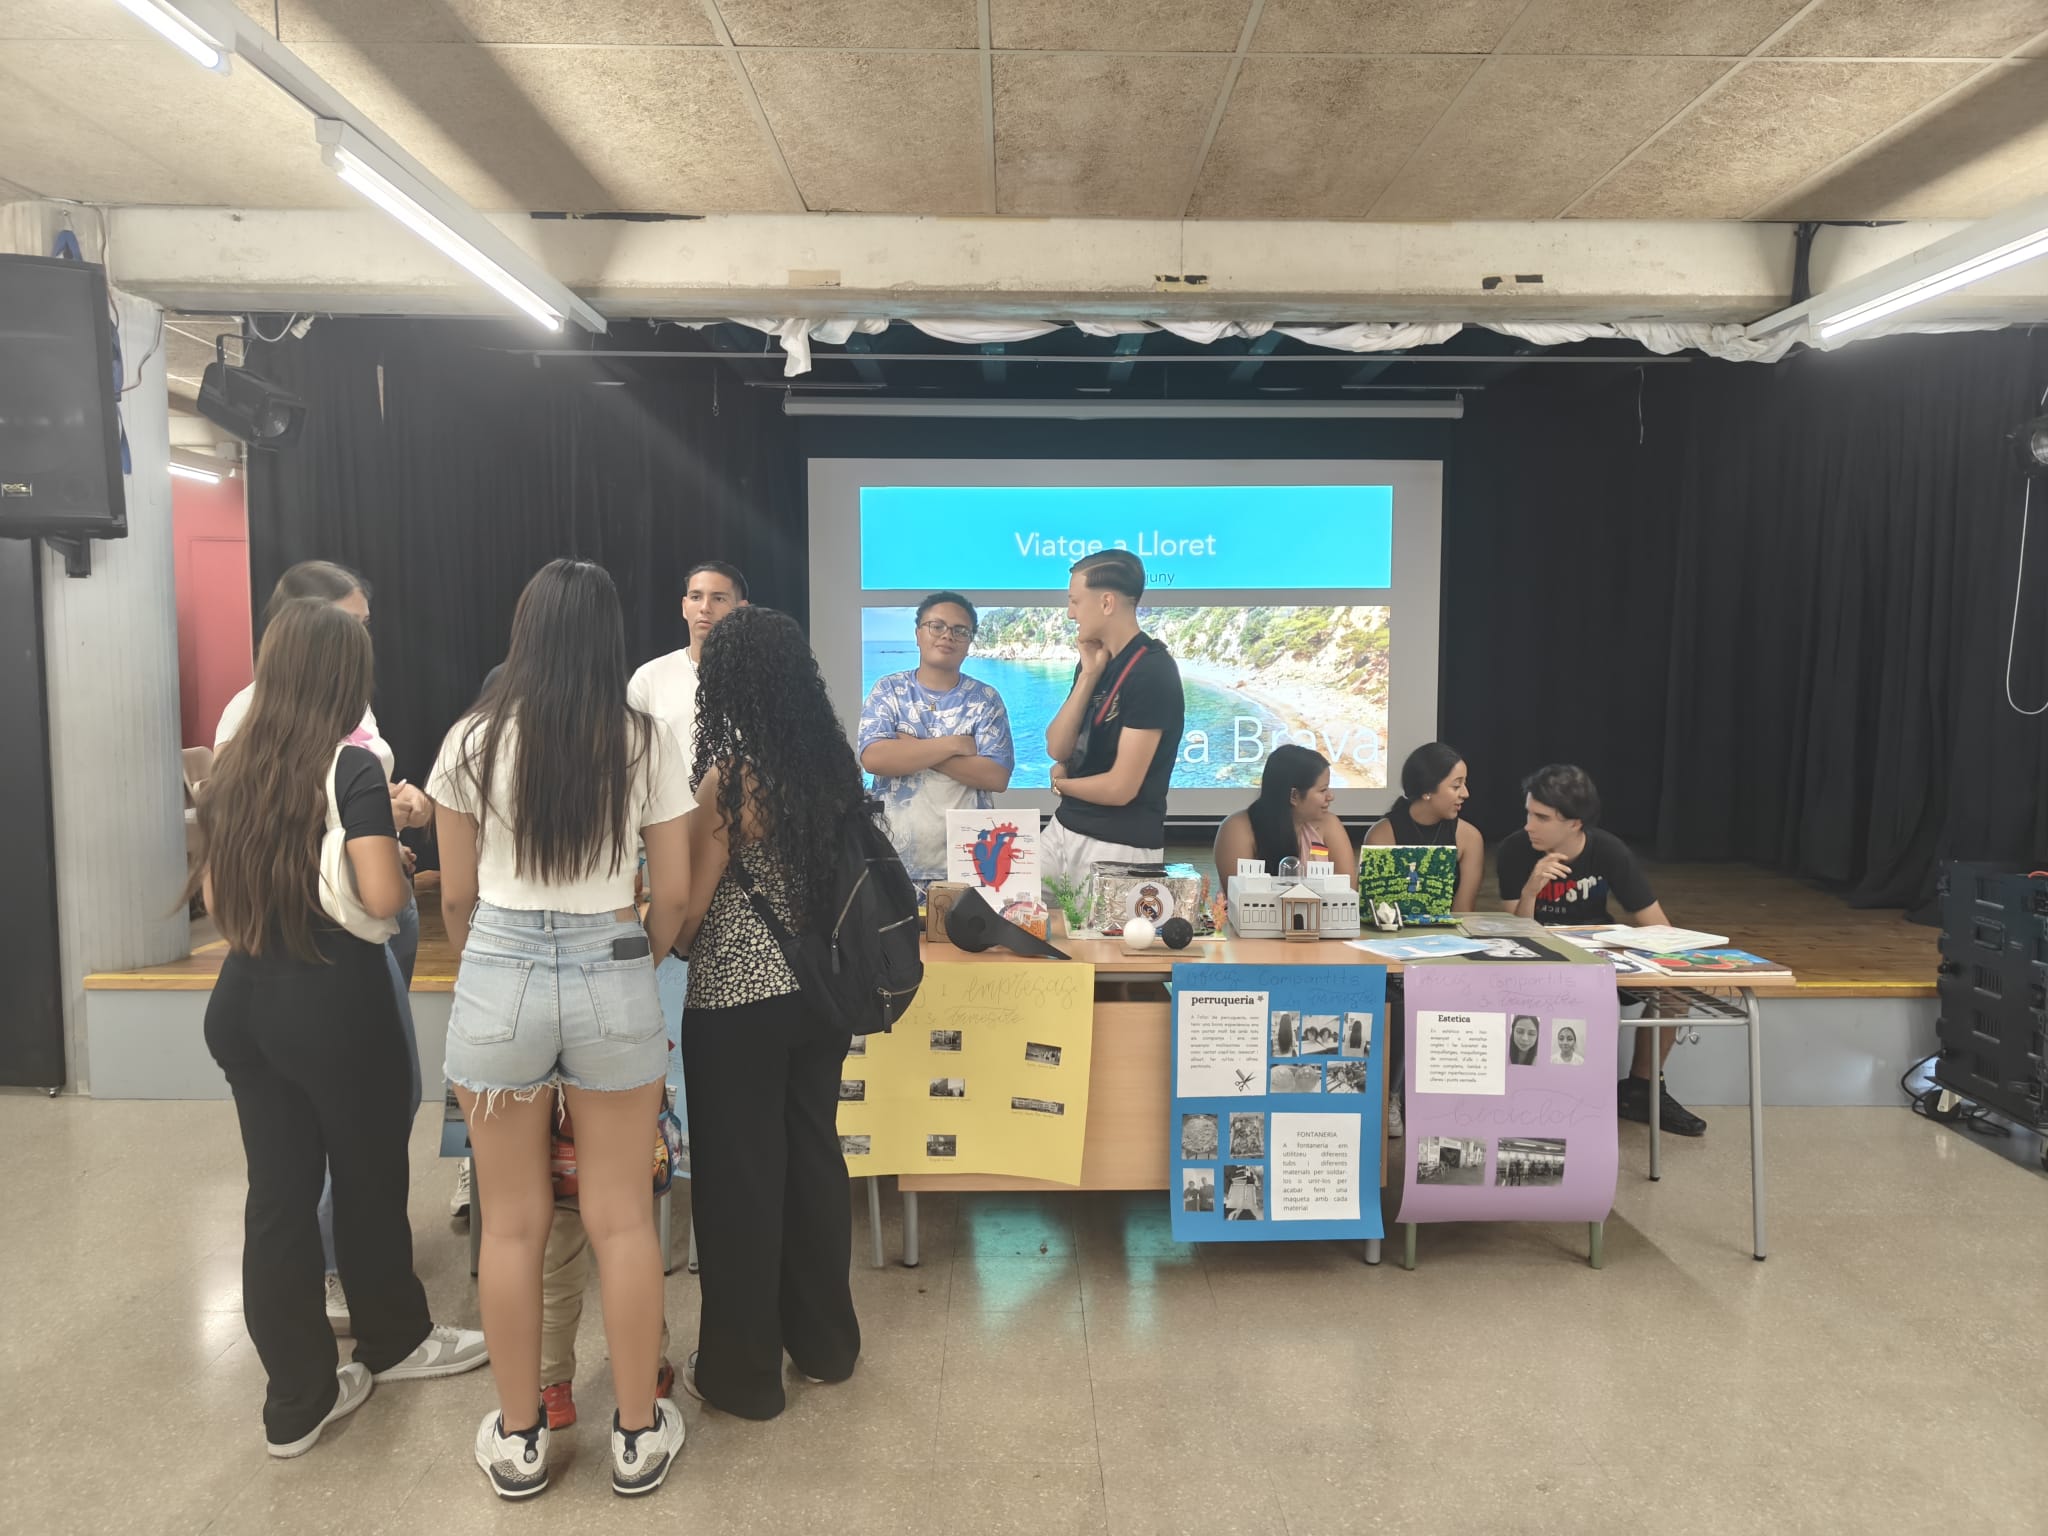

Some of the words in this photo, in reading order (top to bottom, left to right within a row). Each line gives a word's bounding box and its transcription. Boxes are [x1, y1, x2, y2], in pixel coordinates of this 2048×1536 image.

[1015, 531, 1103, 563] Viatge
[1138, 530, 1217, 556] Lloret
[1146, 570, 1175, 586] juny
[1191, 995, 1255, 1006] perruqueria
[1438, 1014, 1471, 1023] Estetica
